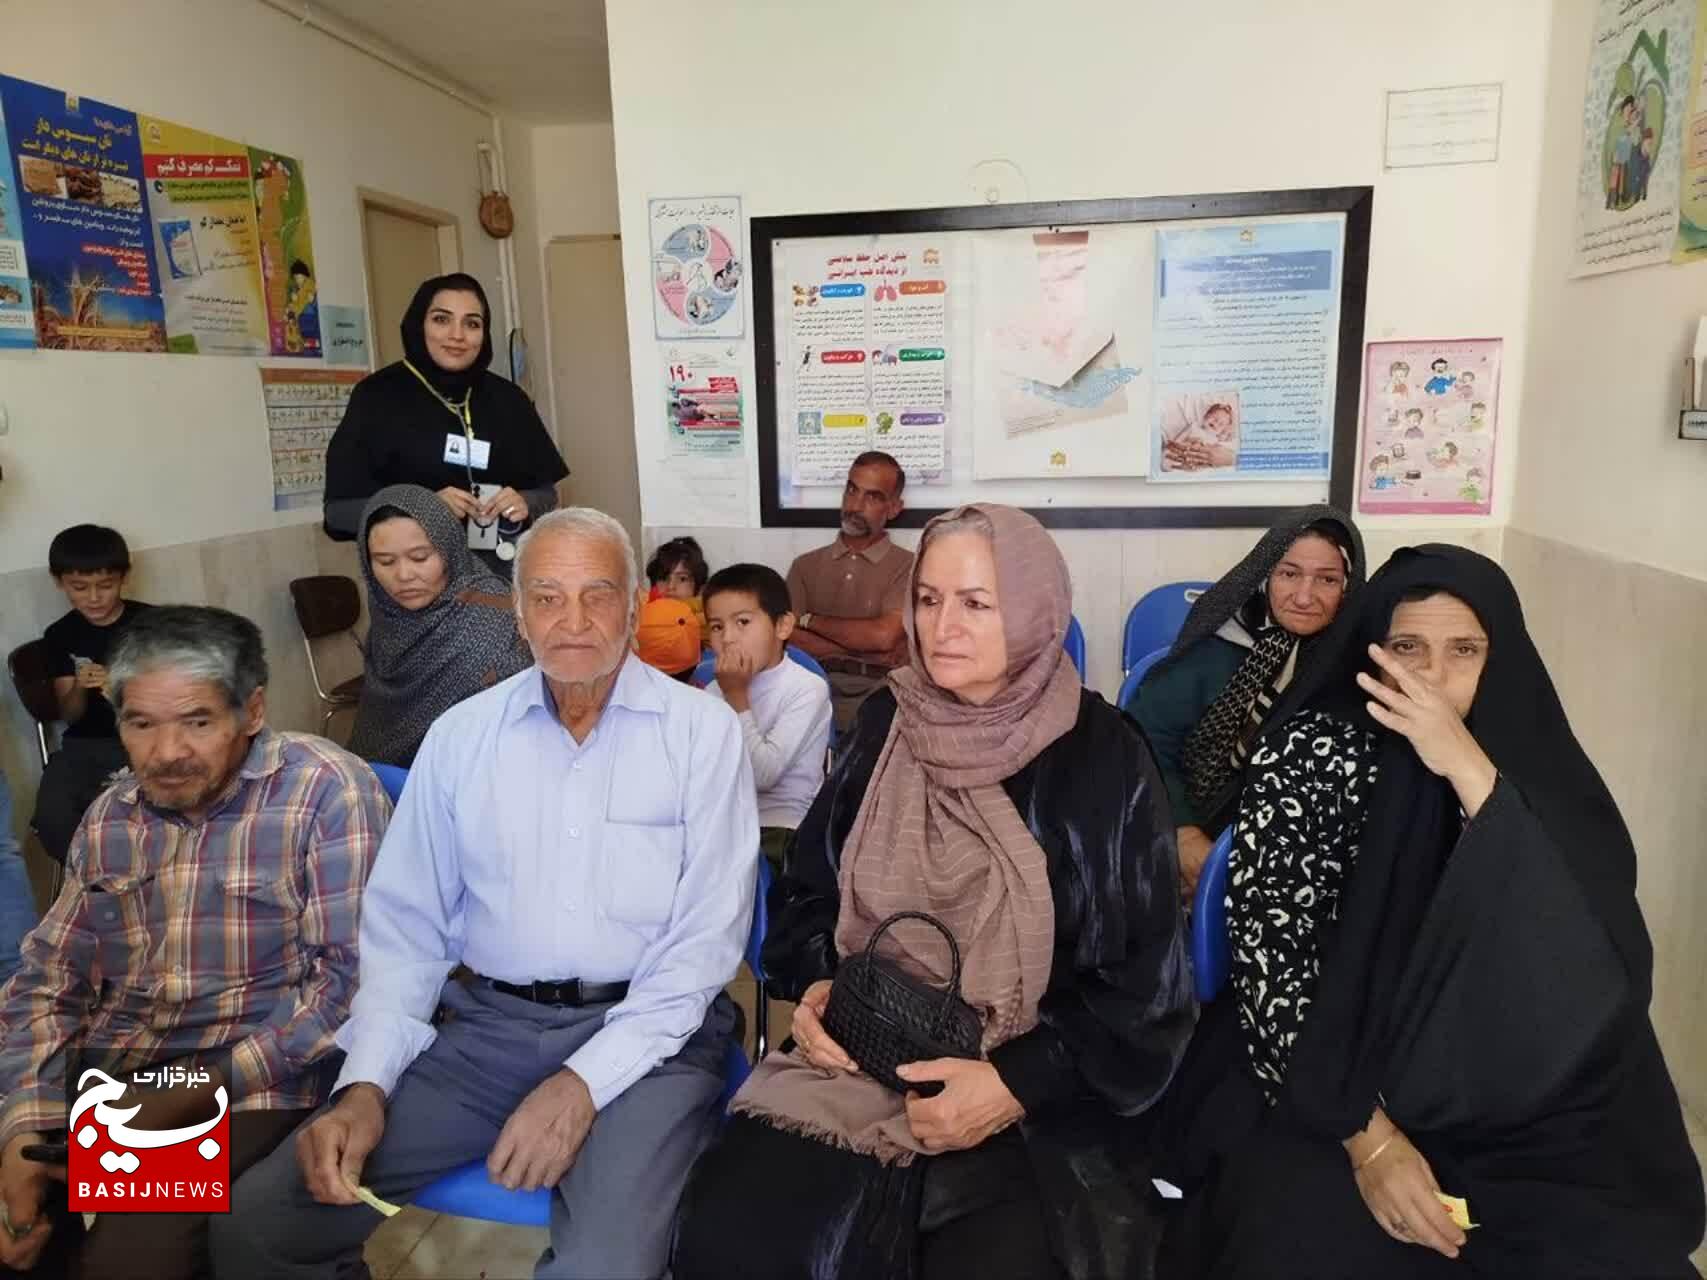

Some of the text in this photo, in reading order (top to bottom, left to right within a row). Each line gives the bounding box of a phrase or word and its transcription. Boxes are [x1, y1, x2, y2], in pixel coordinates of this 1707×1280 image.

[156, 156, 241, 177] نمک کم مصرف کنیم
[669, 364, 693, 382] ۱۹۰
